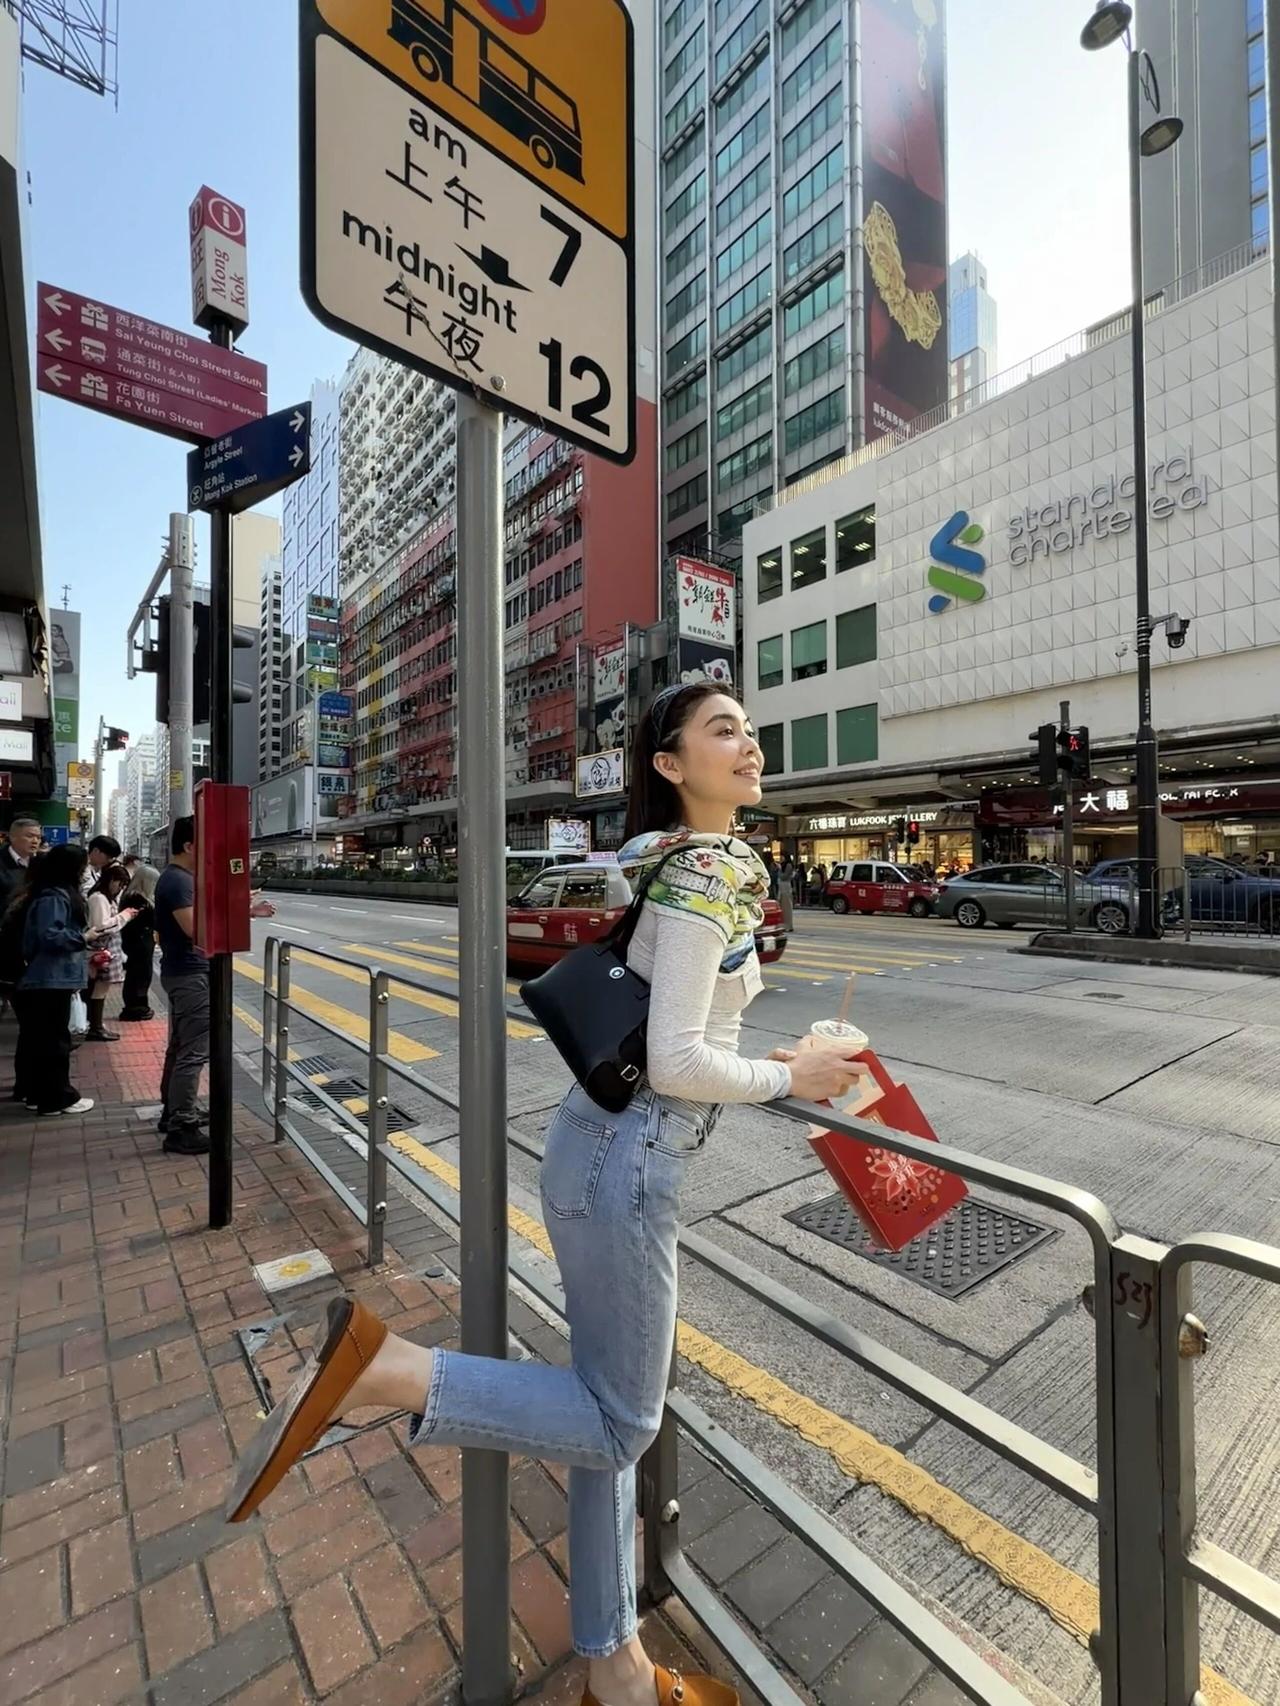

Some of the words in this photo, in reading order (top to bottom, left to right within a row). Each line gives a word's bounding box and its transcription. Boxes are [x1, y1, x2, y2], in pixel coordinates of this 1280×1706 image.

[408, 107, 468, 168] am
[385, 140, 486, 230] 上午
[211, 248, 230, 300] Mong
[342, 209, 518, 333] midnight
[540, 203, 582, 288] 7
[230, 273, 245, 309] Kok
[383, 279, 485, 373] 午夜
[116, 363, 143, 380] Tung
[144, 372, 166, 386] Choi
[168, 381, 195, 396] Street
[137, 337, 172, 356] Yeung
[173, 349, 199, 365] Choi
[201, 358, 231, 377] Street
[233, 371, 262, 388] South
[538, 336, 611, 437] 12
[116, 396, 131, 408] Fa
[135, 403, 167, 419] Yuen
[169, 411, 205, 431] Street
[1007, 444, 1194, 540] standard
[1008, 474, 1209, 567] charteed
[849, 816, 888, 826] LUKFOOK
